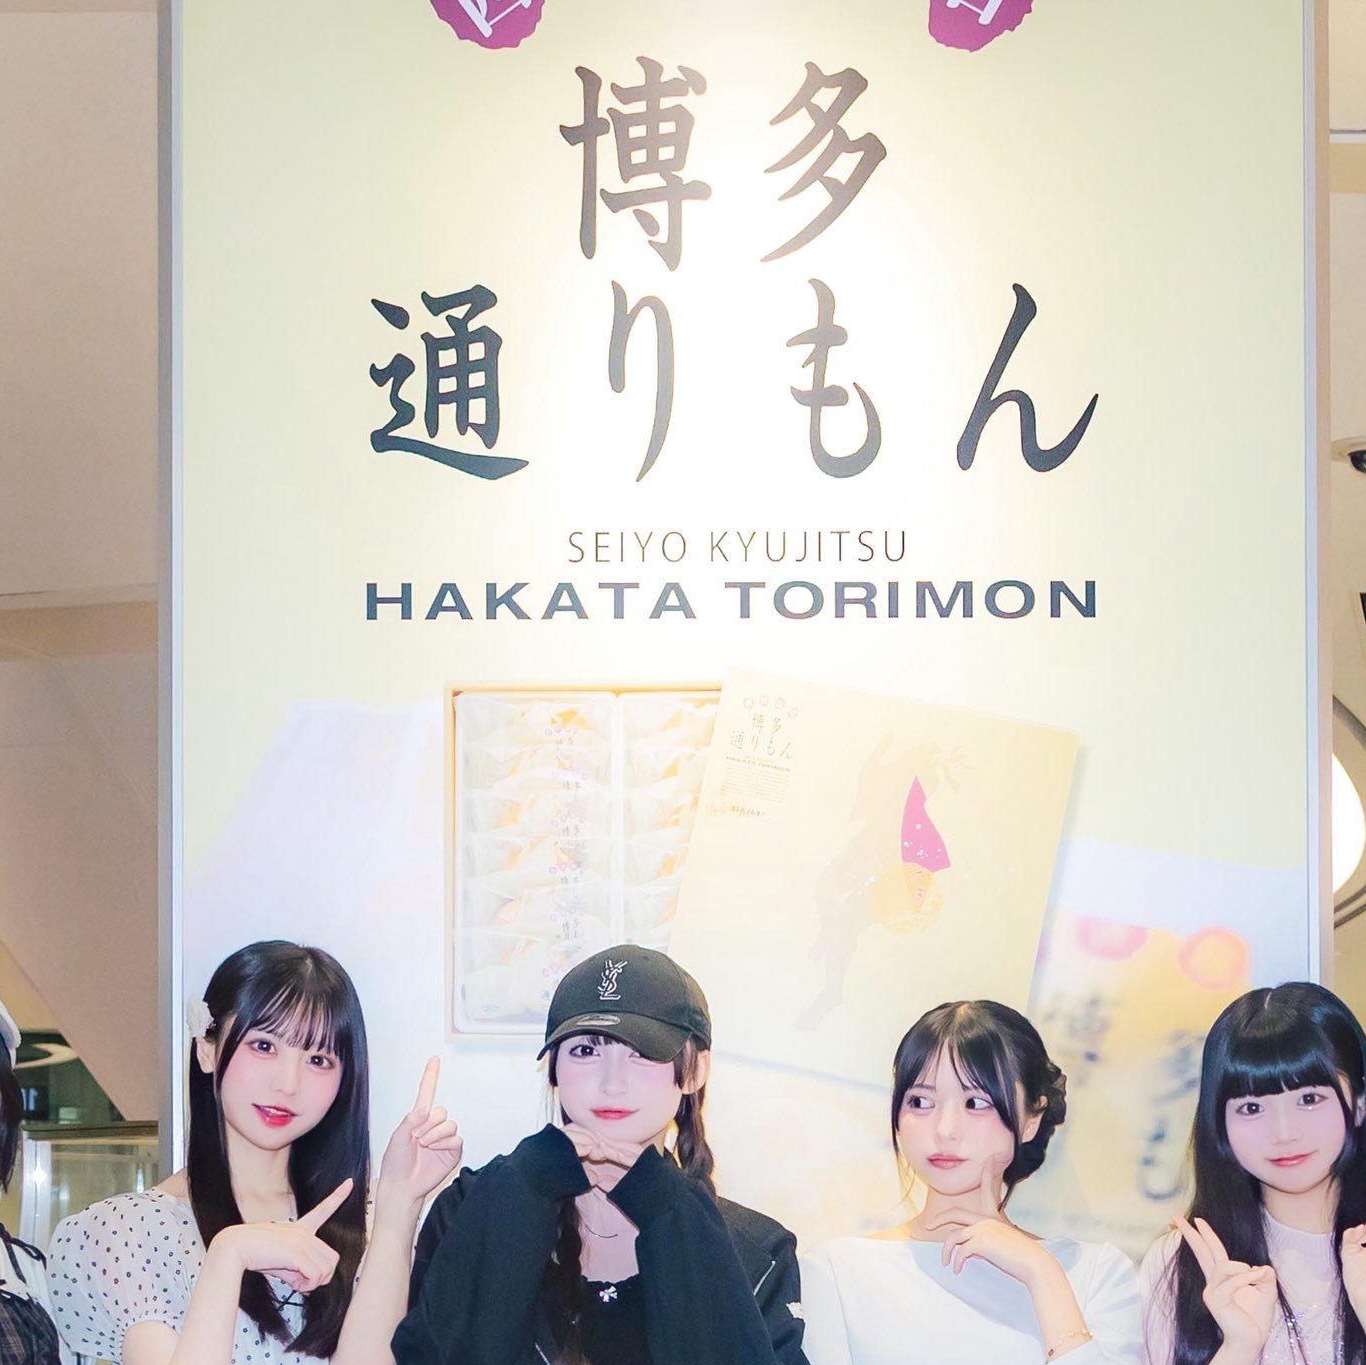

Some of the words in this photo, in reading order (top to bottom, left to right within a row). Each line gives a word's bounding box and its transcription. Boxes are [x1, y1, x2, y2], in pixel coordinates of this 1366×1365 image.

[558, 55, 888, 272] 博多
[368, 277, 1100, 483] 通りもん
[364, 580, 698, 621] HAKATA
[723, 579, 1099, 621] TORIMON
[567, 530, 688, 563] SEIYO
[710, 529, 908, 563] KYUJITSU
